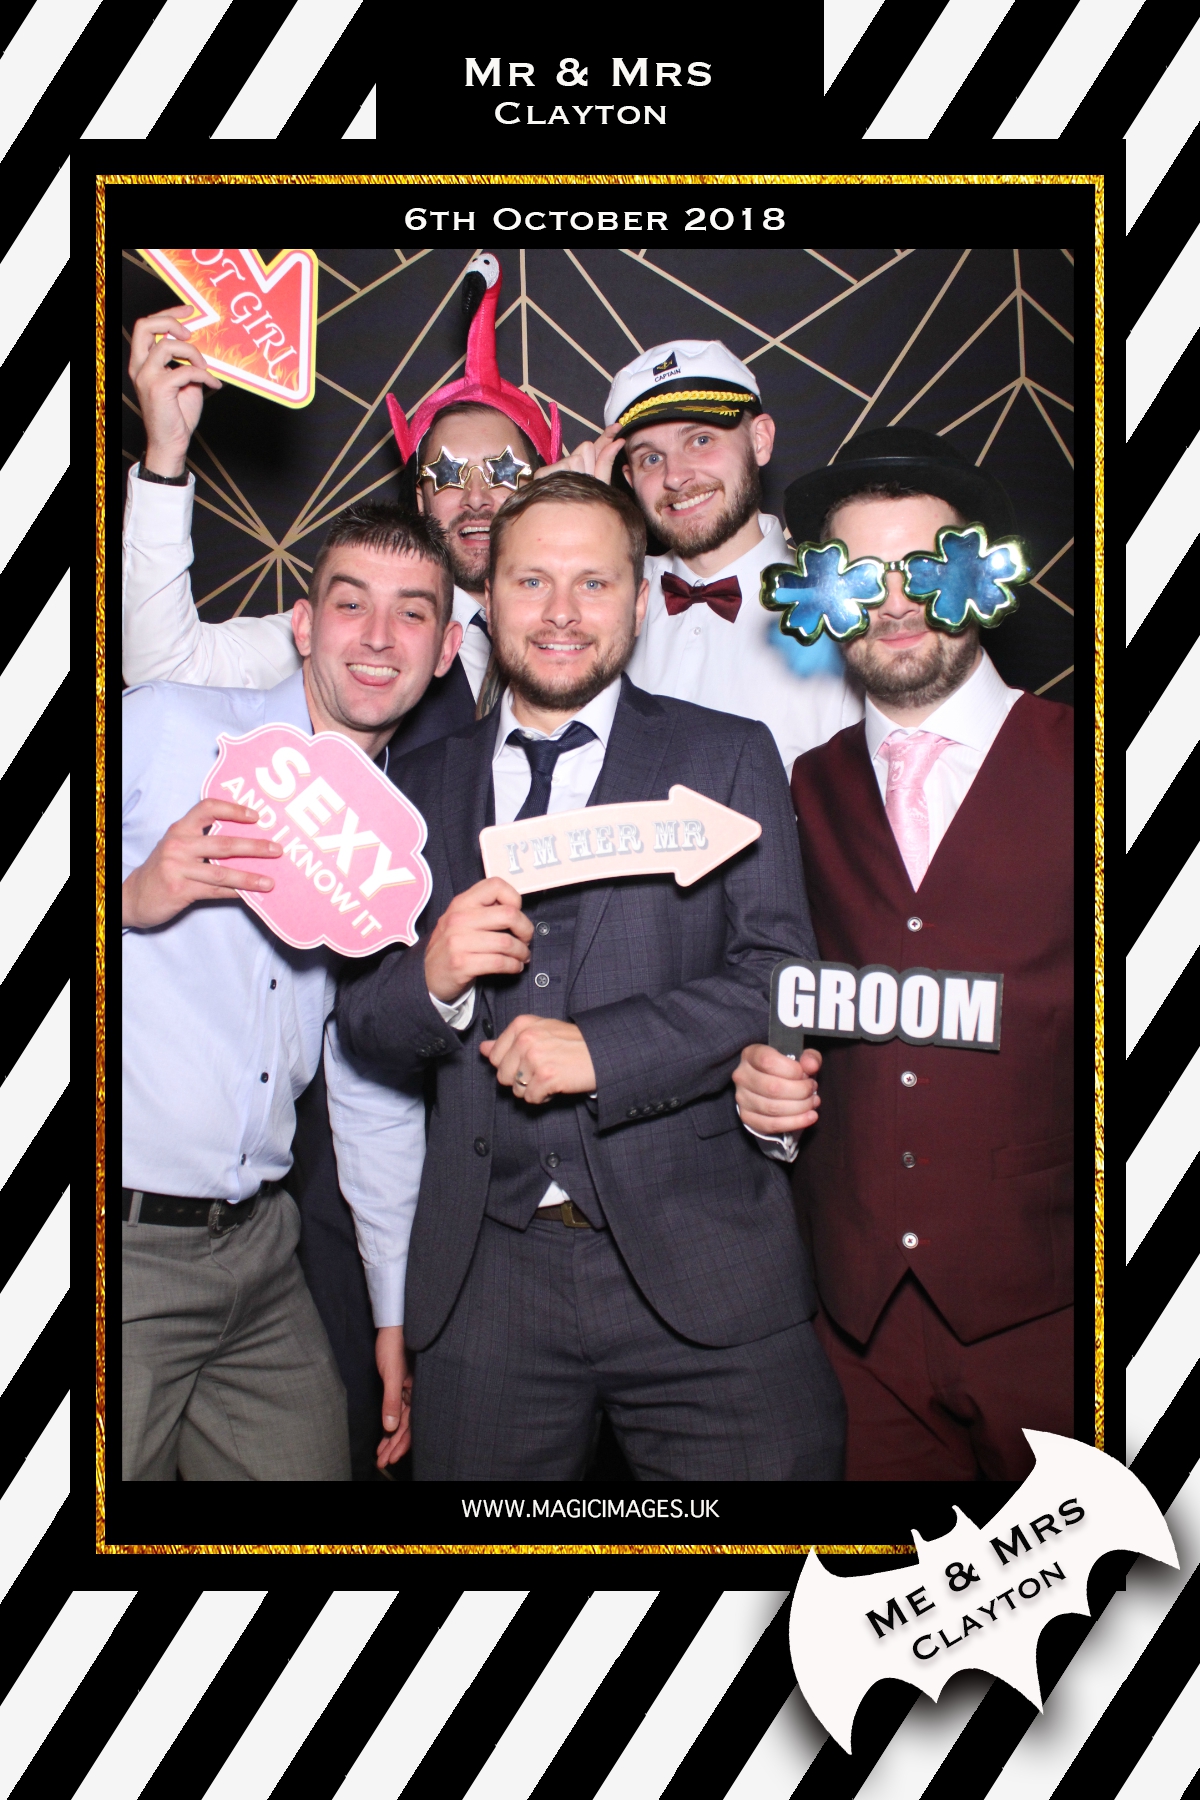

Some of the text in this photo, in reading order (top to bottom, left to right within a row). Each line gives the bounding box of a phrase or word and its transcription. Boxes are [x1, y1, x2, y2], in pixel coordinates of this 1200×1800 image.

[230, 291, 298, 380] GIRL
[654, 367, 682, 383] CAPTAIN
[220, 776, 383, 939] AND I KNOW IT
[255, 746, 417, 901] SEXY
[504, 819, 710, 875] I'M HER MR
[777, 965, 998, 1043] GROOM
